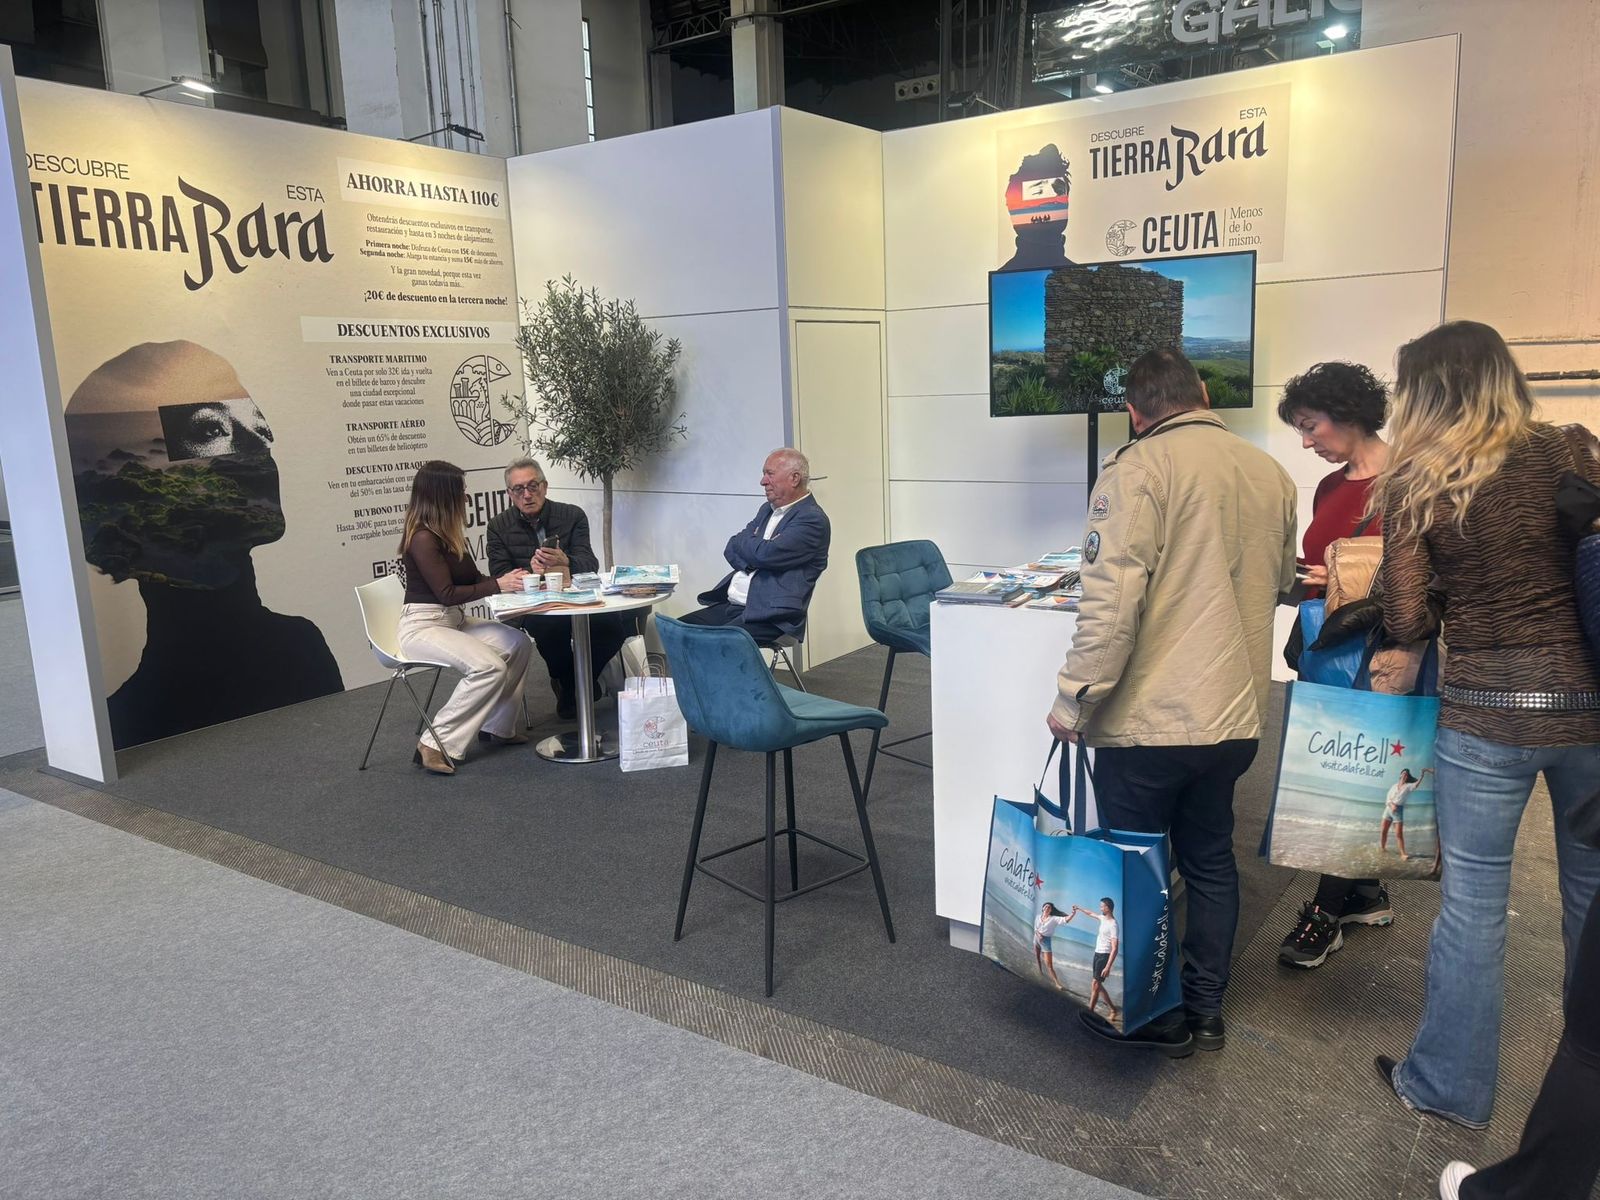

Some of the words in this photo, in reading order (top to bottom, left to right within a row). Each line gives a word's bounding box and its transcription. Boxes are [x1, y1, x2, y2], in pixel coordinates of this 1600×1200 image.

[1240, 107, 1268, 120] ESTA
[1090, 125, 1145, 143] DESCUBRE
[1089, 137, 1171, 180] TIERRA
[1165, 120, 1269, 192] Rara
[286, 184, 325, 203] ESTA
[346, 172, 417, 197] AHORRA
[420, 182, 469, 204] HASTA
[470, 190, 500, 208] 110€
[1230, 206, 1263, 220] Menos
[366, 213, 398, 224] Obtendrás
[399, 217, 430, 228] descuentos
[430, 220, 456, 230] exclusivos
[1229, 221, 1242, 233] de
[1242, 220, 1252, 232] lo
[178, 175, 335, 291] Rara
[366, 226, 403, 235] restauración
[404, 230, 408, 238] y
[409, 228, 424, 237] hasta
[438, 232, 456, 240] noches
[1142, 210, 1220, 254] CEUTA
[366, 240, 390, 249] Primera
[1228, 234, 1262, 247] mismo.
[360, 248, 386, 257] Segunda
[390, 264, 396, 274] Y
[397, 266, 402, 274] la
[404, 268, 417, 276] gran
[442, 271, 460, 280] porque
[412, 279, 428, 288] ganas
[364, 290, 384, 302] ¡20€
[386, 291, 396, 301] de
[398, 292, 437, 302] descuento
[438, 295, 448, 303] en
[449, 294, 457, 304] la
[458, 296, 484, 305] tercera
[485, 296, 508, 306] noche!
[337, 323, 420, 338] DESCUENTOS
[422, 325, 491, 339] EXCLUSIVOS
[329, 354, 385, 364] TRANSPORTE
[326, 368, 338, 376] Ven
[344, 368, 363, 376] Ceuta
[364, 368, 374, 377] por
[375, 367, 387, 376] solo
[388, 367, 400, 375] 32€
[401, 367, 410, 375] ida
[411, 368, 414, 376] y
[352, 378, 370, 386] billete
[372, 378, 378, 386] de
[380, 378, 396, 386] barco
[396, 379, 400, 387] y
[401, 377, 426, 385] descubre
[362, 388, 382, 396] ciudad
[384, 387, 416, 397] excepcional
[342, 400, 360, 408] donde
[362, 400, 378, 408] pasar
[346, 420, 399, 432] TRANSPORTE
[400, 418, 426, 428] AÉREO
[347, 435, 366, 444] Obtén
[376, 434, 390, 442] 65%
[391, 433, 398, 441] de
[398, 432, 426, 440] descuento
[367, 445, 388, 453] billetes
[397, 442, 428, 451] helicóptero
[345, 463, 394, 476] DESCUENTO
[394, 461, 428, 471] ATRAQU
[328, 481, 340, 489] Ven
[358, 476, 394, 487] embarcación
[361, 488, 374, 496] 50%
[353, 506, 393, 518] BUYBONO
[464, 489, 512, 529] CEUT
[336, 524, 355, 533] Hasta
[356, 520, 372, 530] 300€
[374, 520, 387, 529] para
[351, 530, 381, 540] recargable
[1308, 731, 1389, 765] Calafell
[1000, 848, 1036, 887] Calafe
